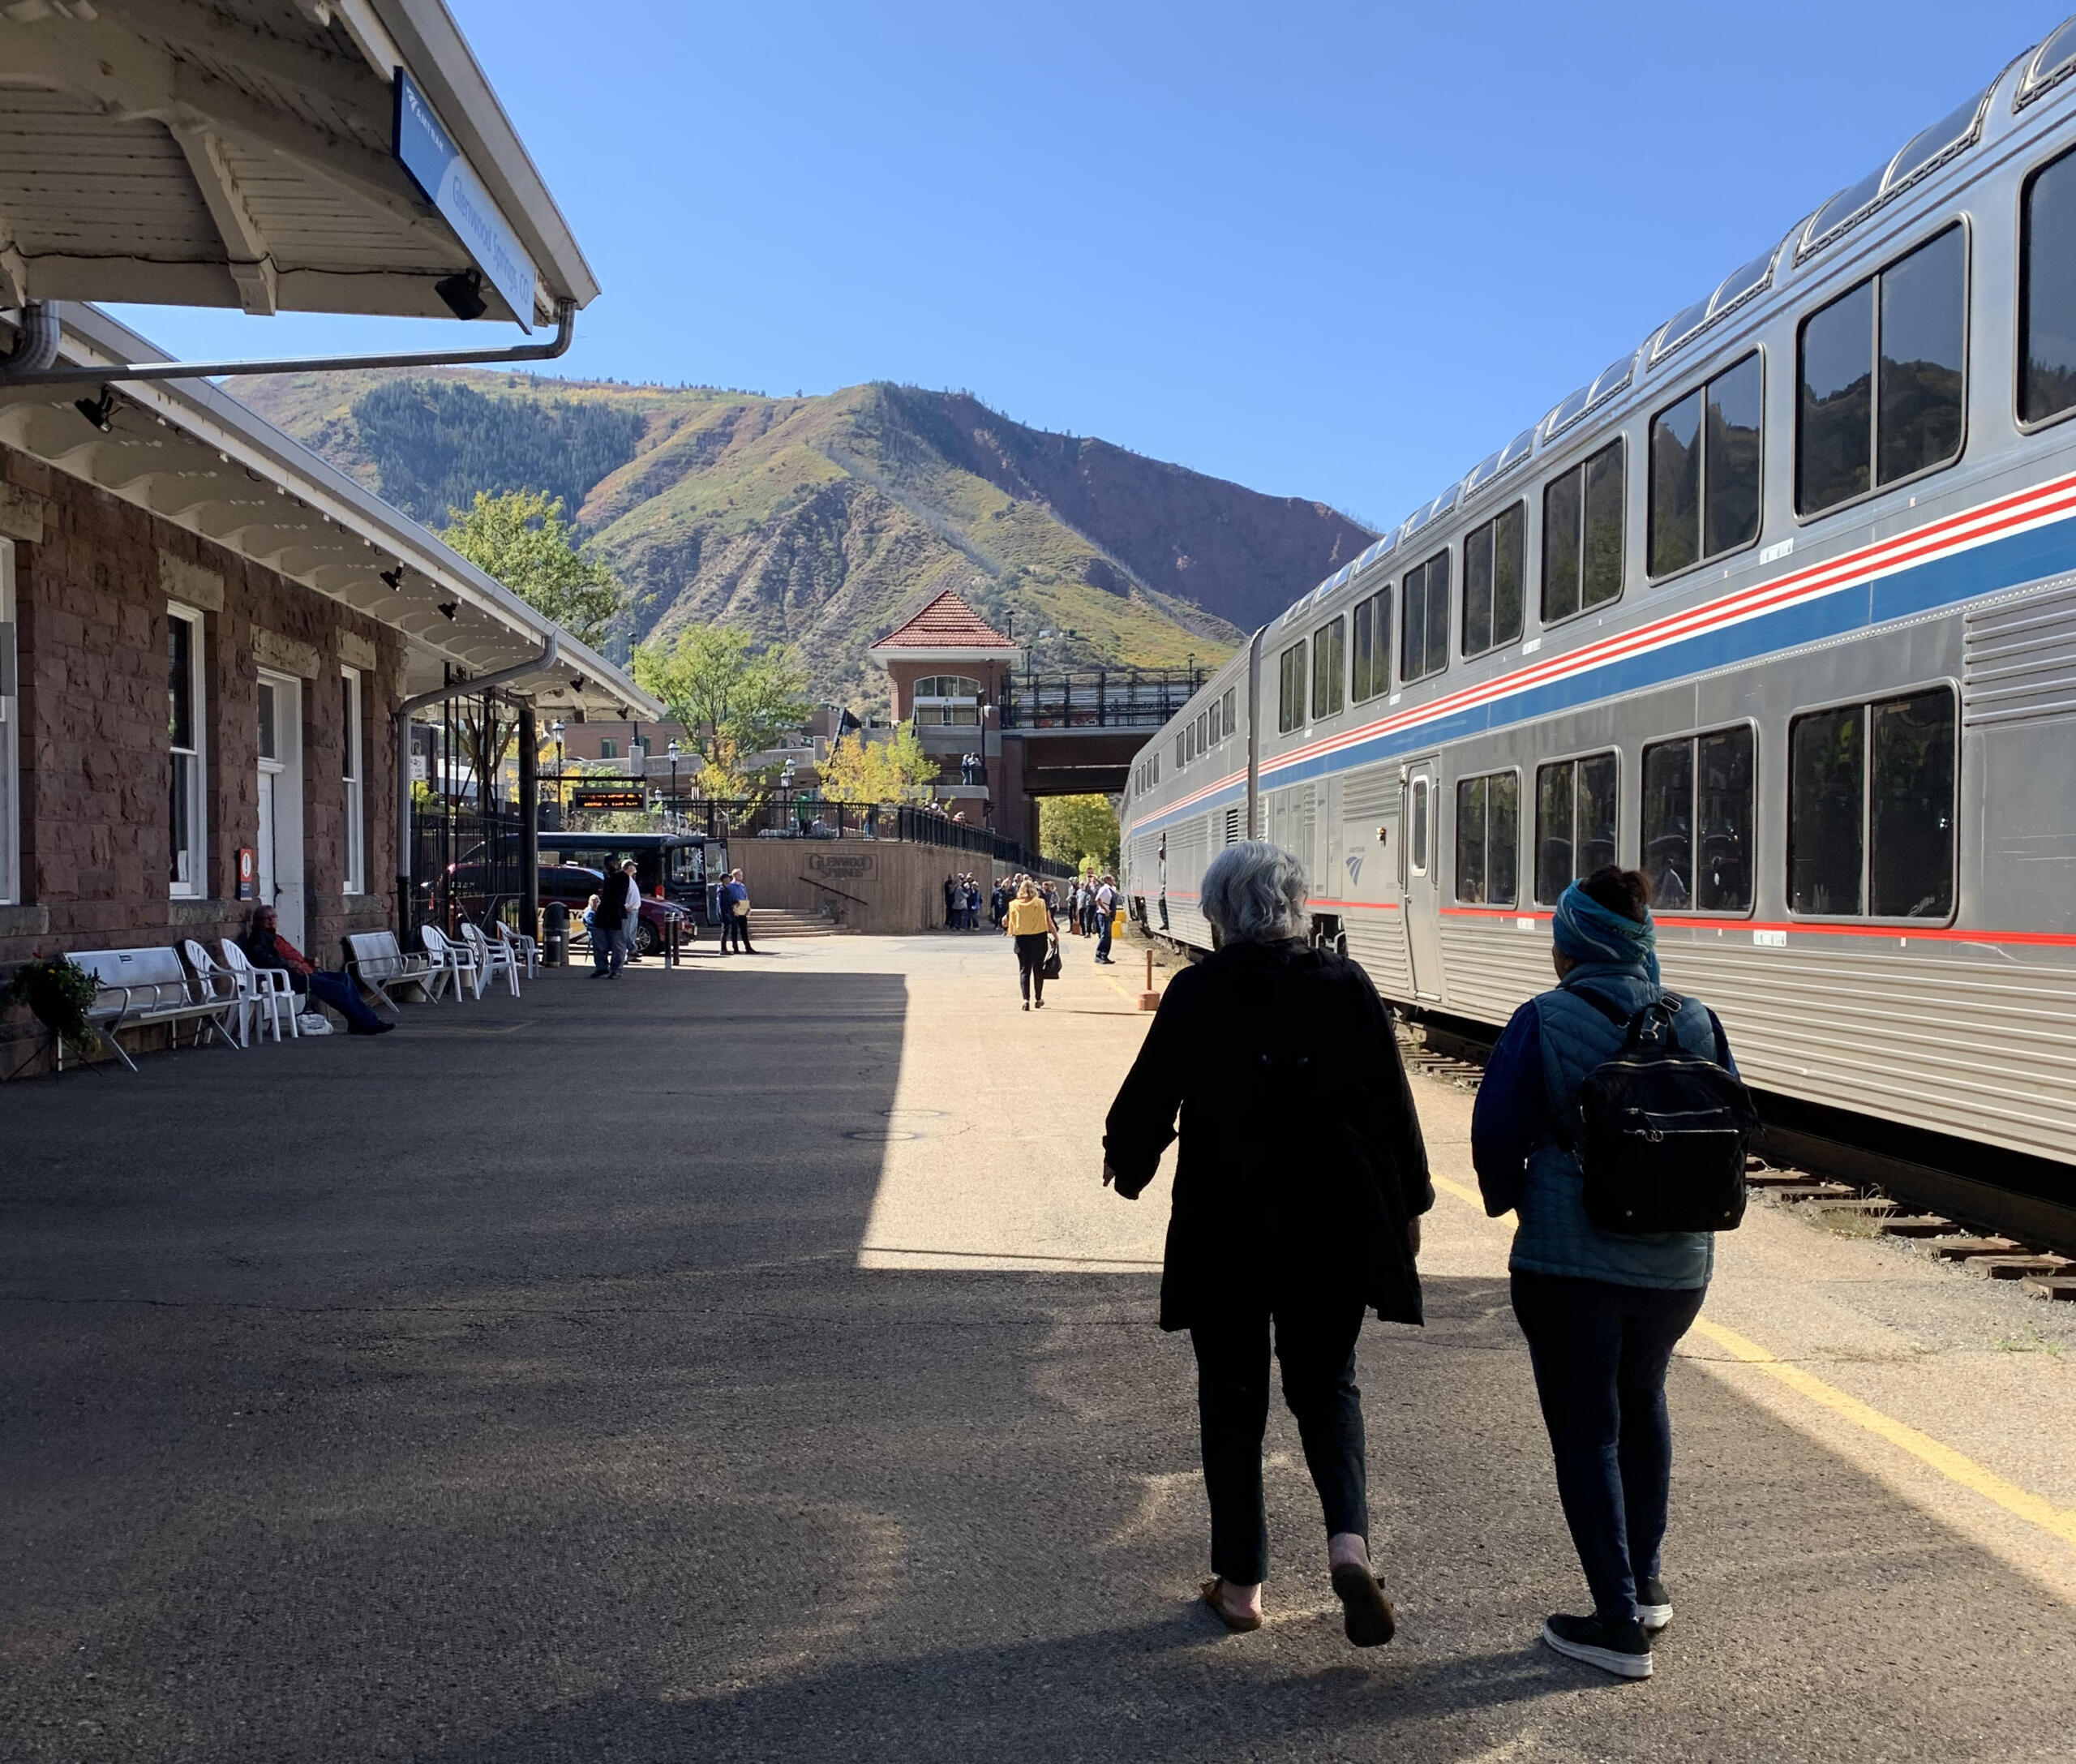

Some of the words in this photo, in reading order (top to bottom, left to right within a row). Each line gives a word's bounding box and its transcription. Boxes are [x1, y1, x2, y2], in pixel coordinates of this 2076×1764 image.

[416, 107, 444, 155] AMTRAK
[453, 175, 491, 253] Glenwood
[519, 273, 530, 305] CO
